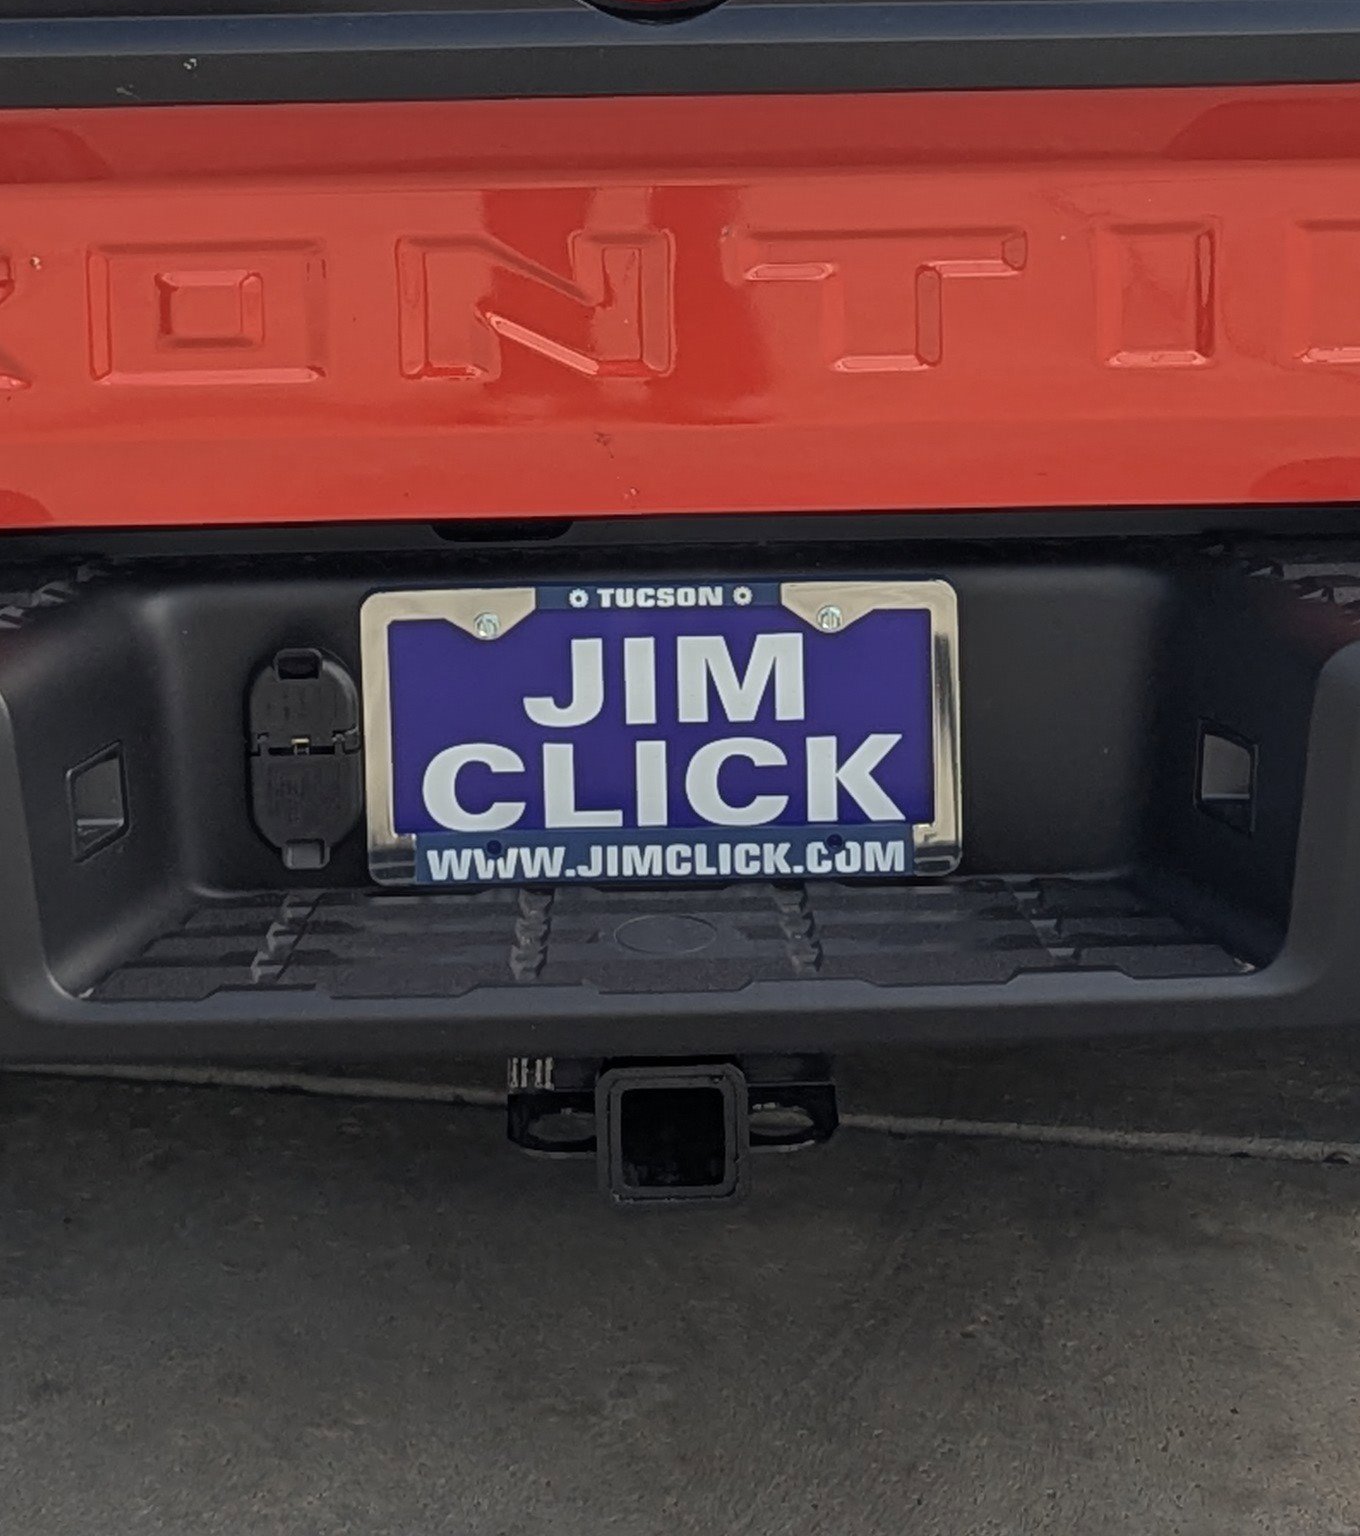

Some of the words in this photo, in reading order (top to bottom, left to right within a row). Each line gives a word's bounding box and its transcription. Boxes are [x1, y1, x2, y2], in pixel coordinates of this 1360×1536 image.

[597, 586, 723, 607] TUCSON
[523, 633, 805, 728] JIM
[422, 734, 906, 832] CLICK
[426, 840, 906, 881] WWW.JIMCLICK.COM
